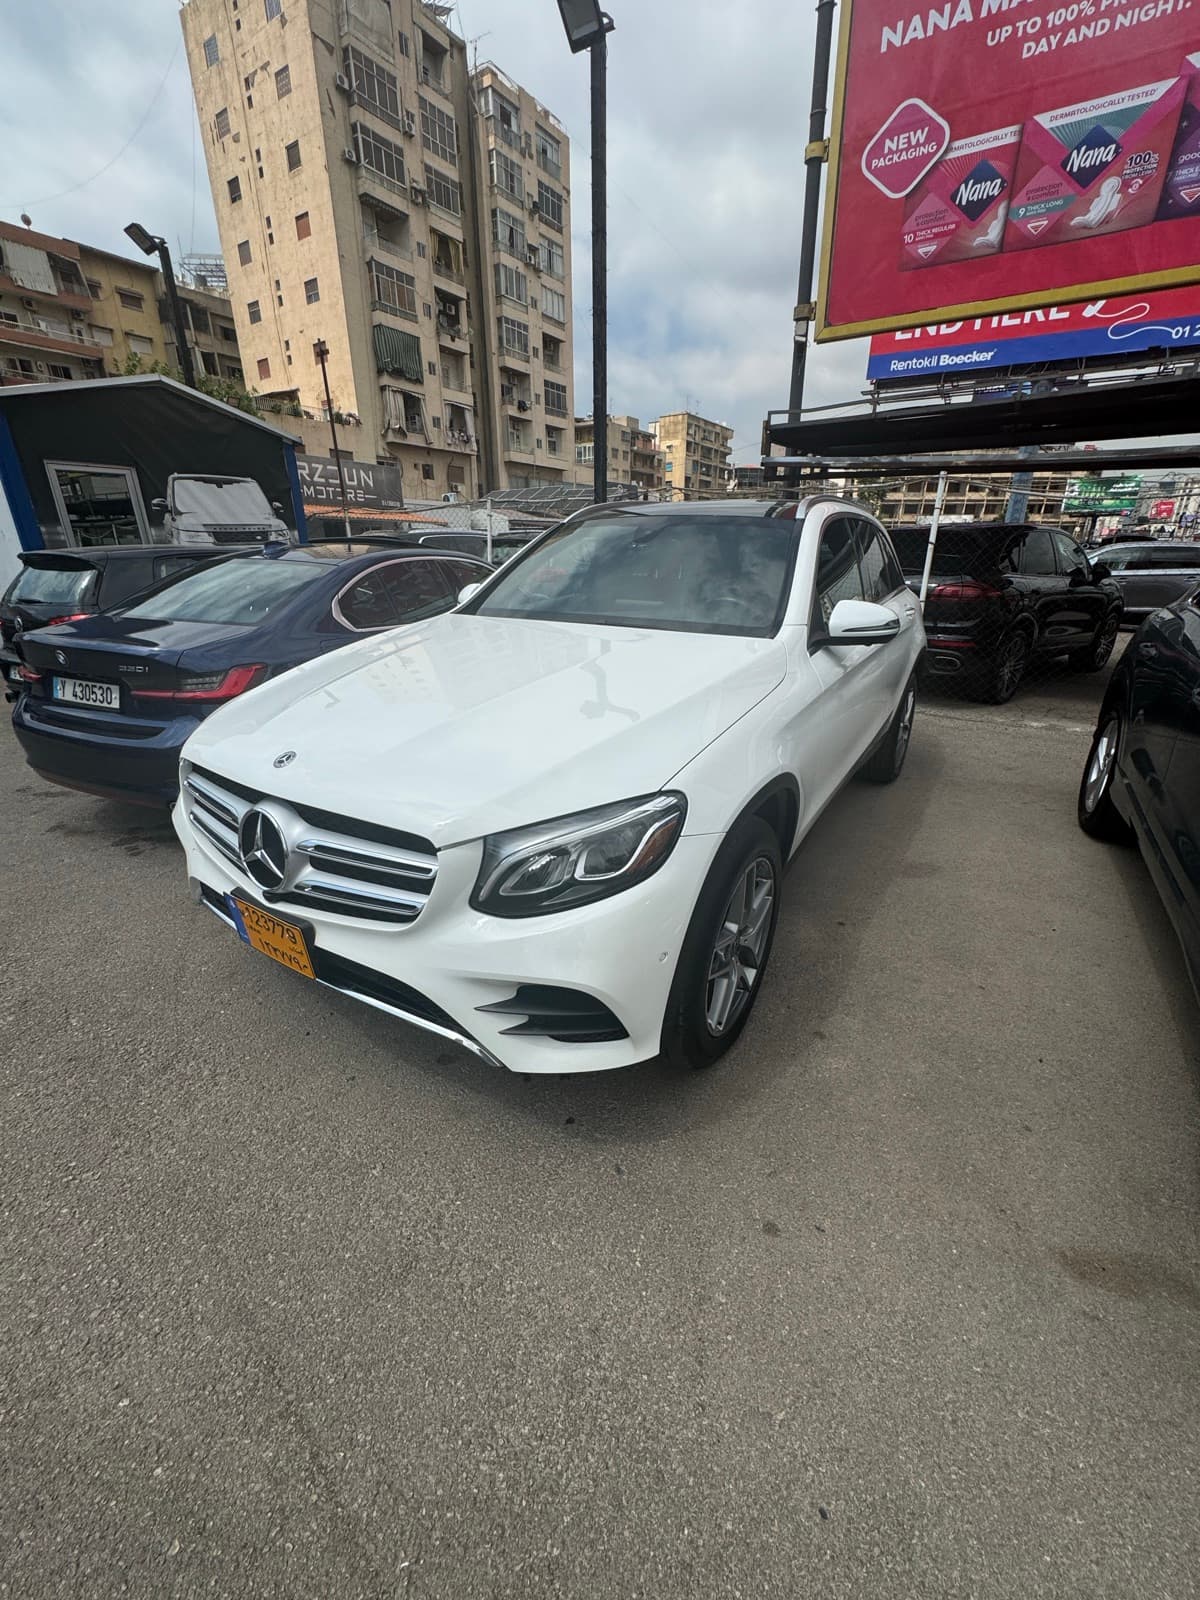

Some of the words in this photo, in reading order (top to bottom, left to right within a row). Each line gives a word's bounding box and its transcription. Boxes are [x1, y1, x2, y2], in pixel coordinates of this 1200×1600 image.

[880, 0, 973, 53] NANA
[986, 25, 1013, 46] UP
[1016, 16, 1042, 37] TO
[1046, 0, 1096, 28] 100%
[1022, 32, 1062, 60] DAY
[1063, 18, 1110, 47] AND
[1049, 96, 1126, 122] DERMATOLOGICALLY
[884, 127, 929, 154] NEW
[871, 142, 938, 170] PACKAGING
[1066, 143, 1117, 173] Nana
[955, 178, 1002, 205] Nana
[1018, 207, 1026, 218] 9
[903, 233, 914, 244] 10
[890, 355, 938, 371] Rentokil
[940, 350, 994, 366] Boecker
[60, 680, 66, 698] Y
[72, 681, 113, 705] 430530
